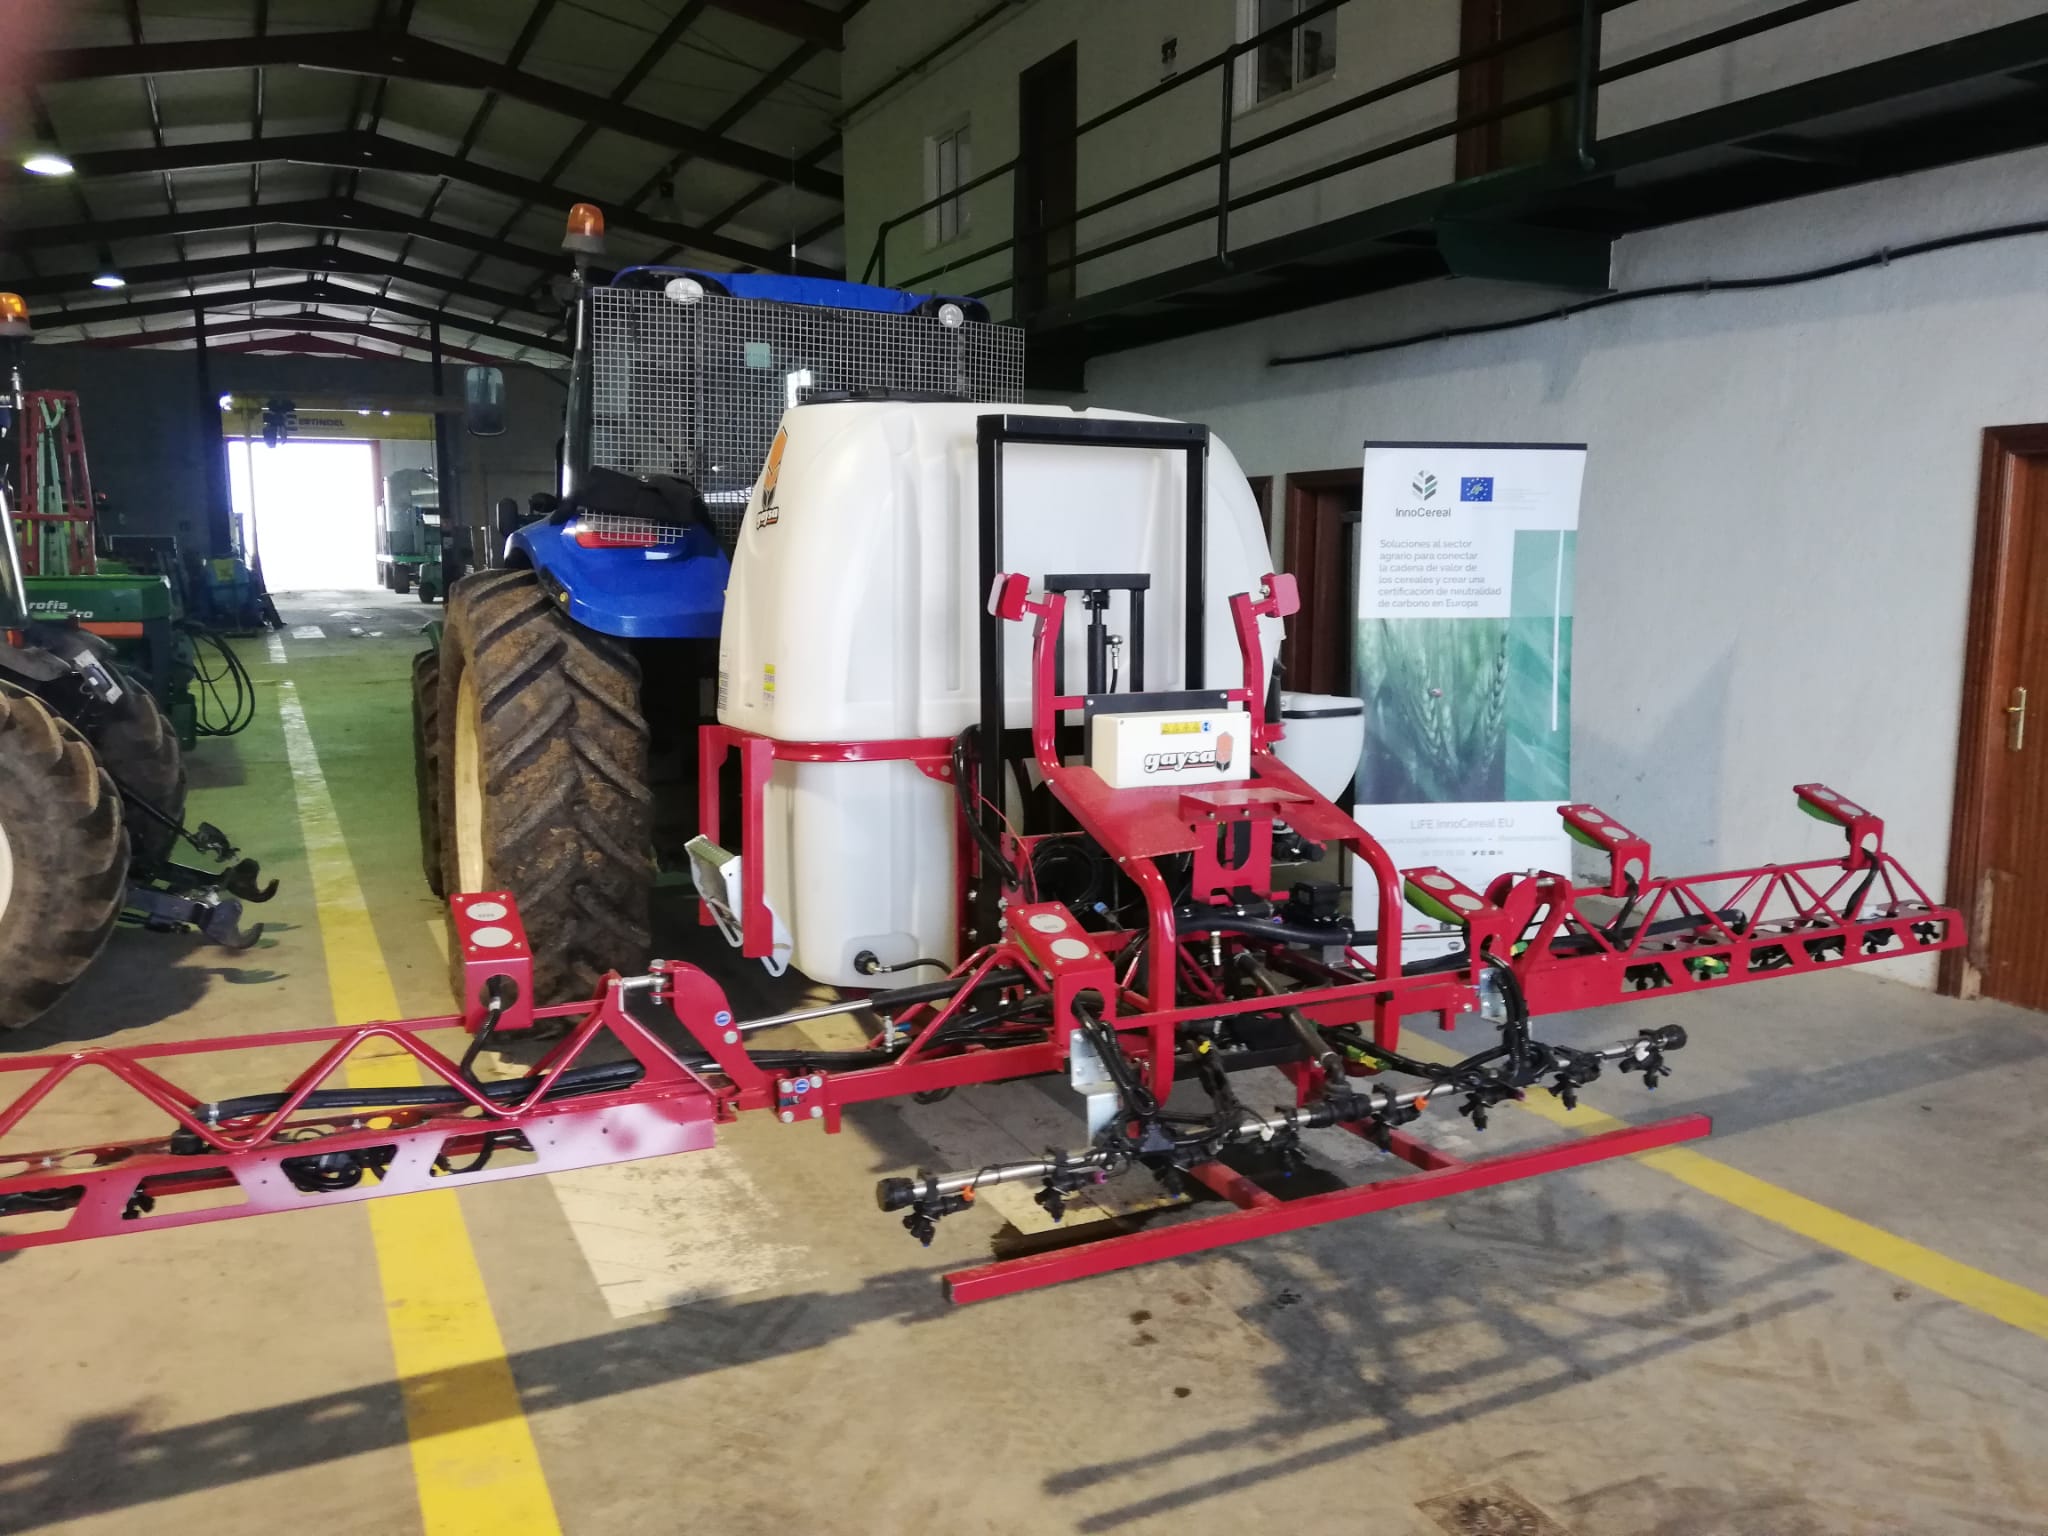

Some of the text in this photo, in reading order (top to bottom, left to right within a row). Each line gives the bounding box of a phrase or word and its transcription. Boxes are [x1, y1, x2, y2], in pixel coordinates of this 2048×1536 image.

[1395, 507, 1451, 518] InnoCereal
[1380, 539, 1472, 548] Soluciones al sector
[1379, 551, 1478, 561] agrario para conectar
[1390, 563, 1424, 572] cadena
[1426, 563, 1437, 572] de
[1440, 563, 1463, 572] valor
[1465, 563, 1477, 572] de
[1379, 575, 1485, 585] los cereales y crear una
[1436, 587, 1448, 596] de
[1450, 587, 1502, 596] neutralidad
[28, 600, 69, 610] rofis
[1378, 599, 1479, 609] de carbono en Europa
[1144, 750, 1217, 773] gaysa
[1410, 818, 1514, 830] LIFE InnoCereal EU
